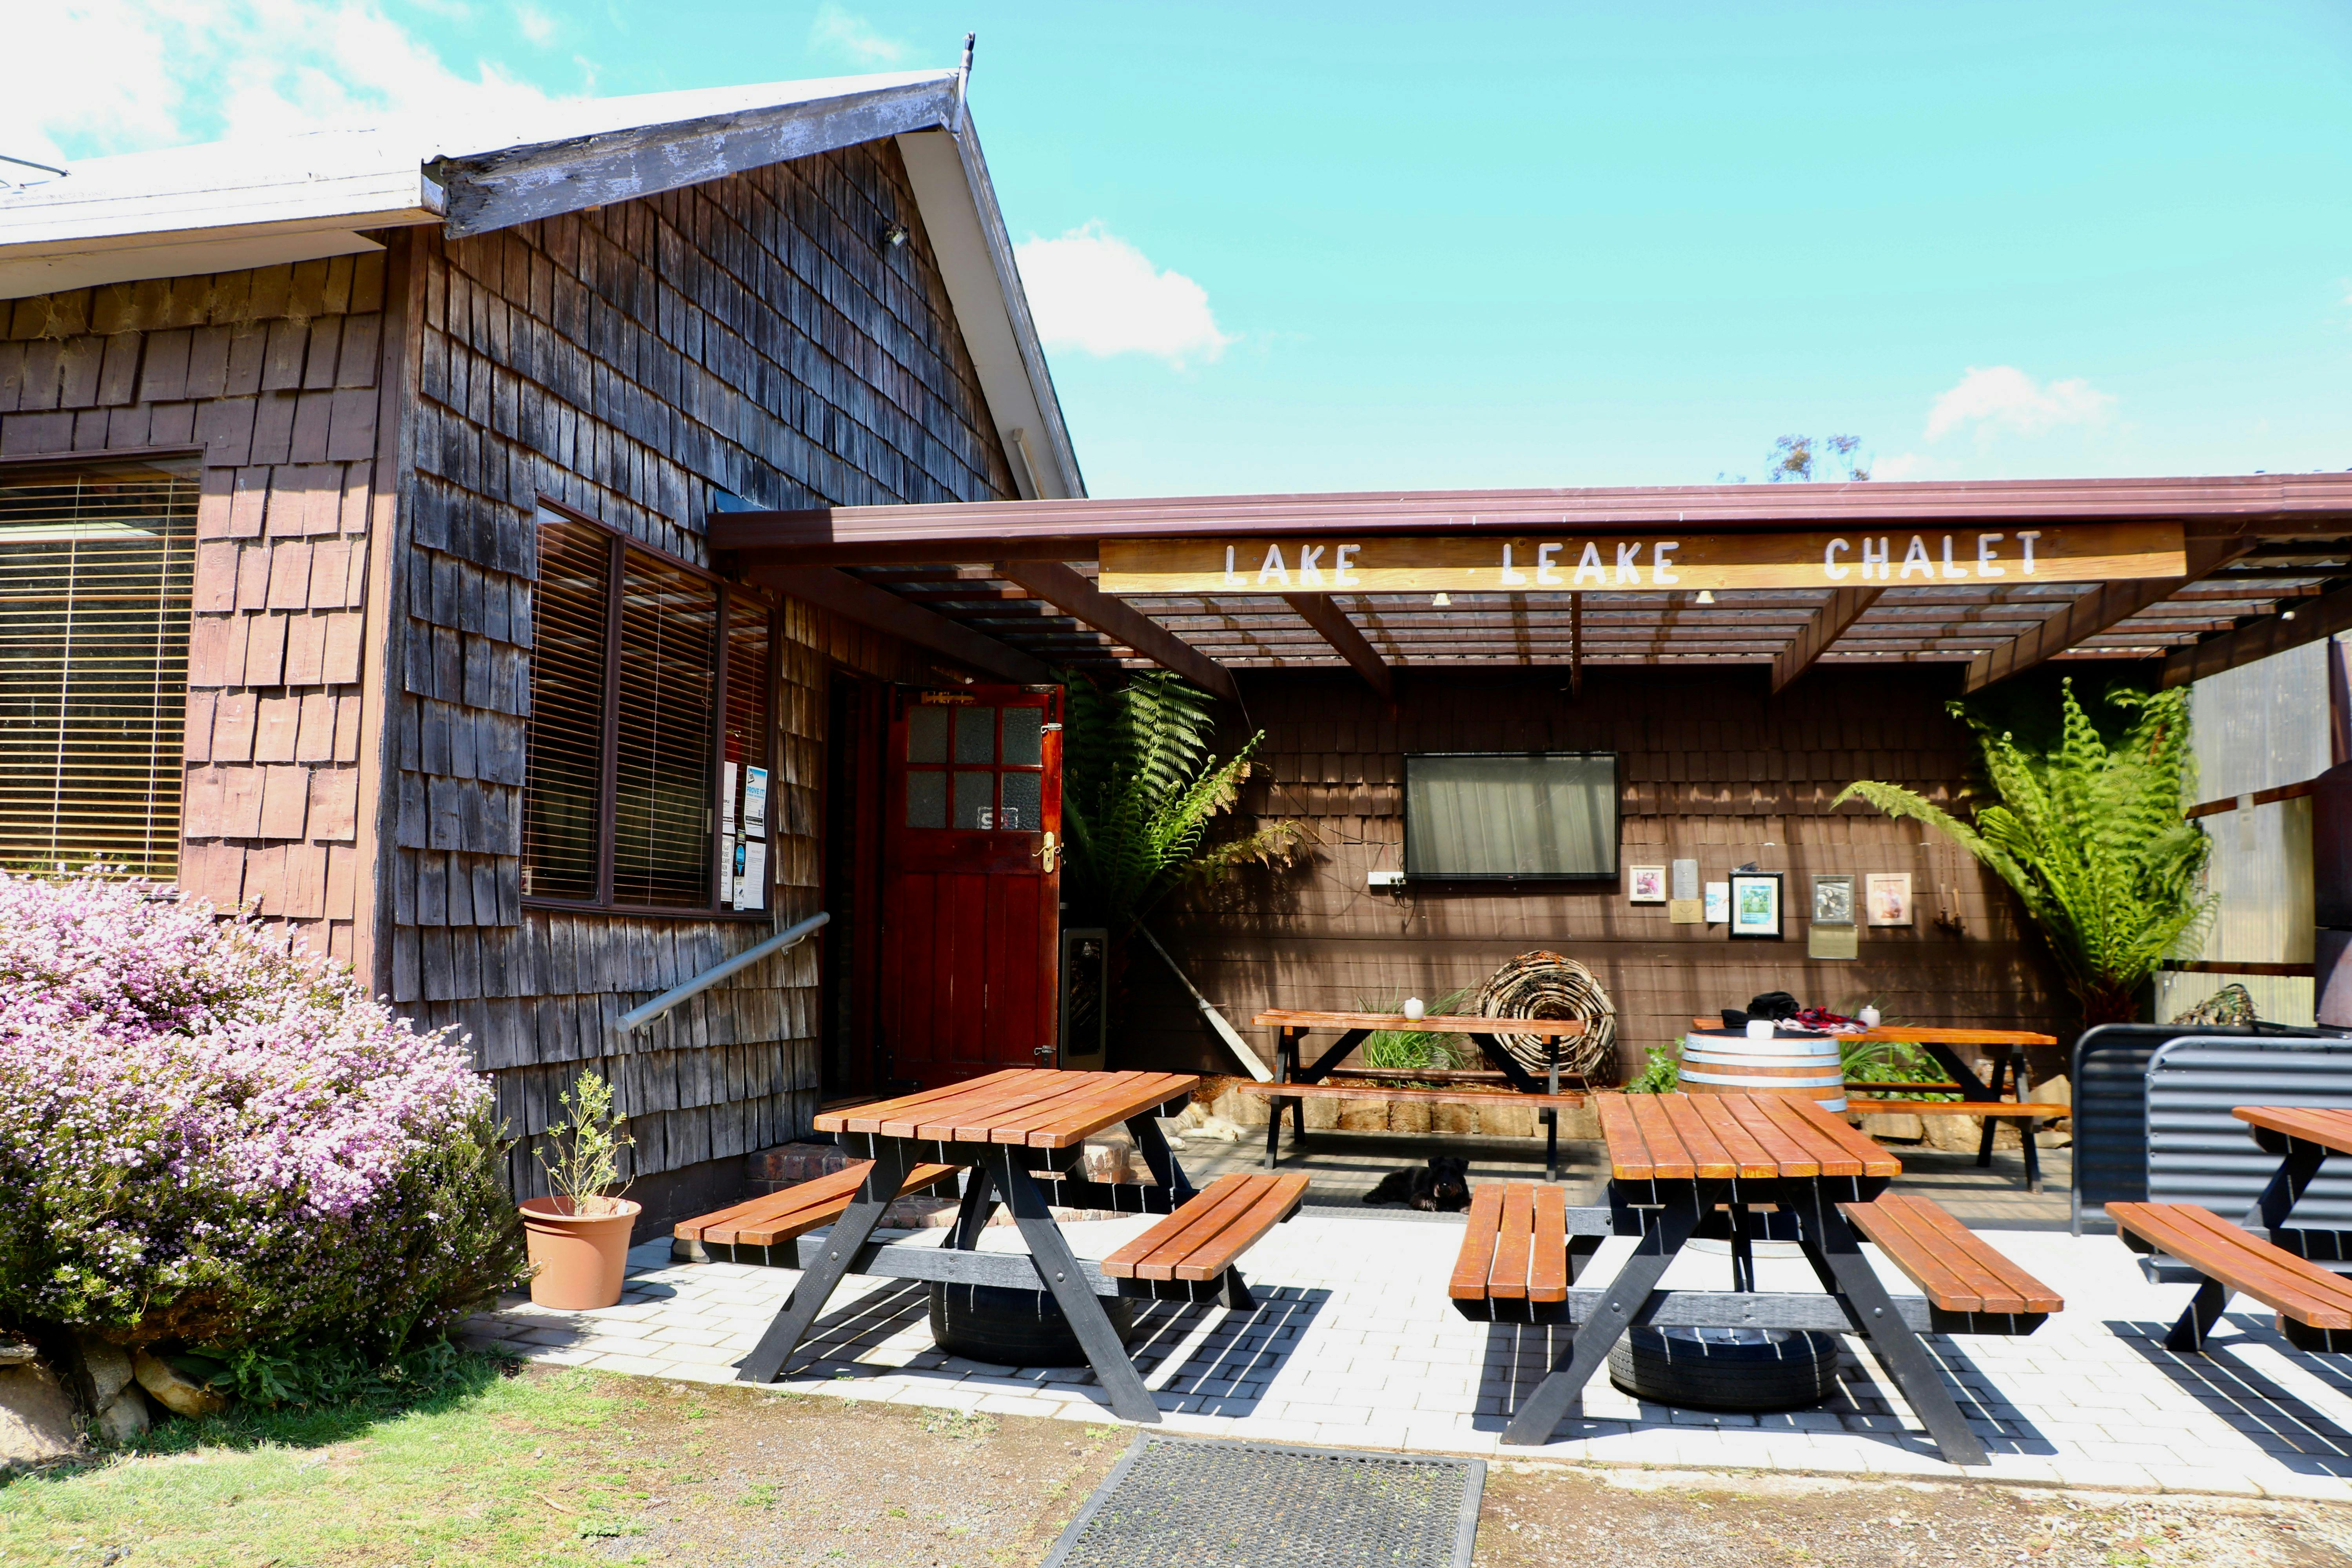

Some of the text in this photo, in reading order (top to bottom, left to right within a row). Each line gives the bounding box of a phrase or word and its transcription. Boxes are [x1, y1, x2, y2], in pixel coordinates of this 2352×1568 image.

[1225, 530, 2042, 586] LAKE LEAKE CHALET
[747, 786, 759, 795] PROVE
